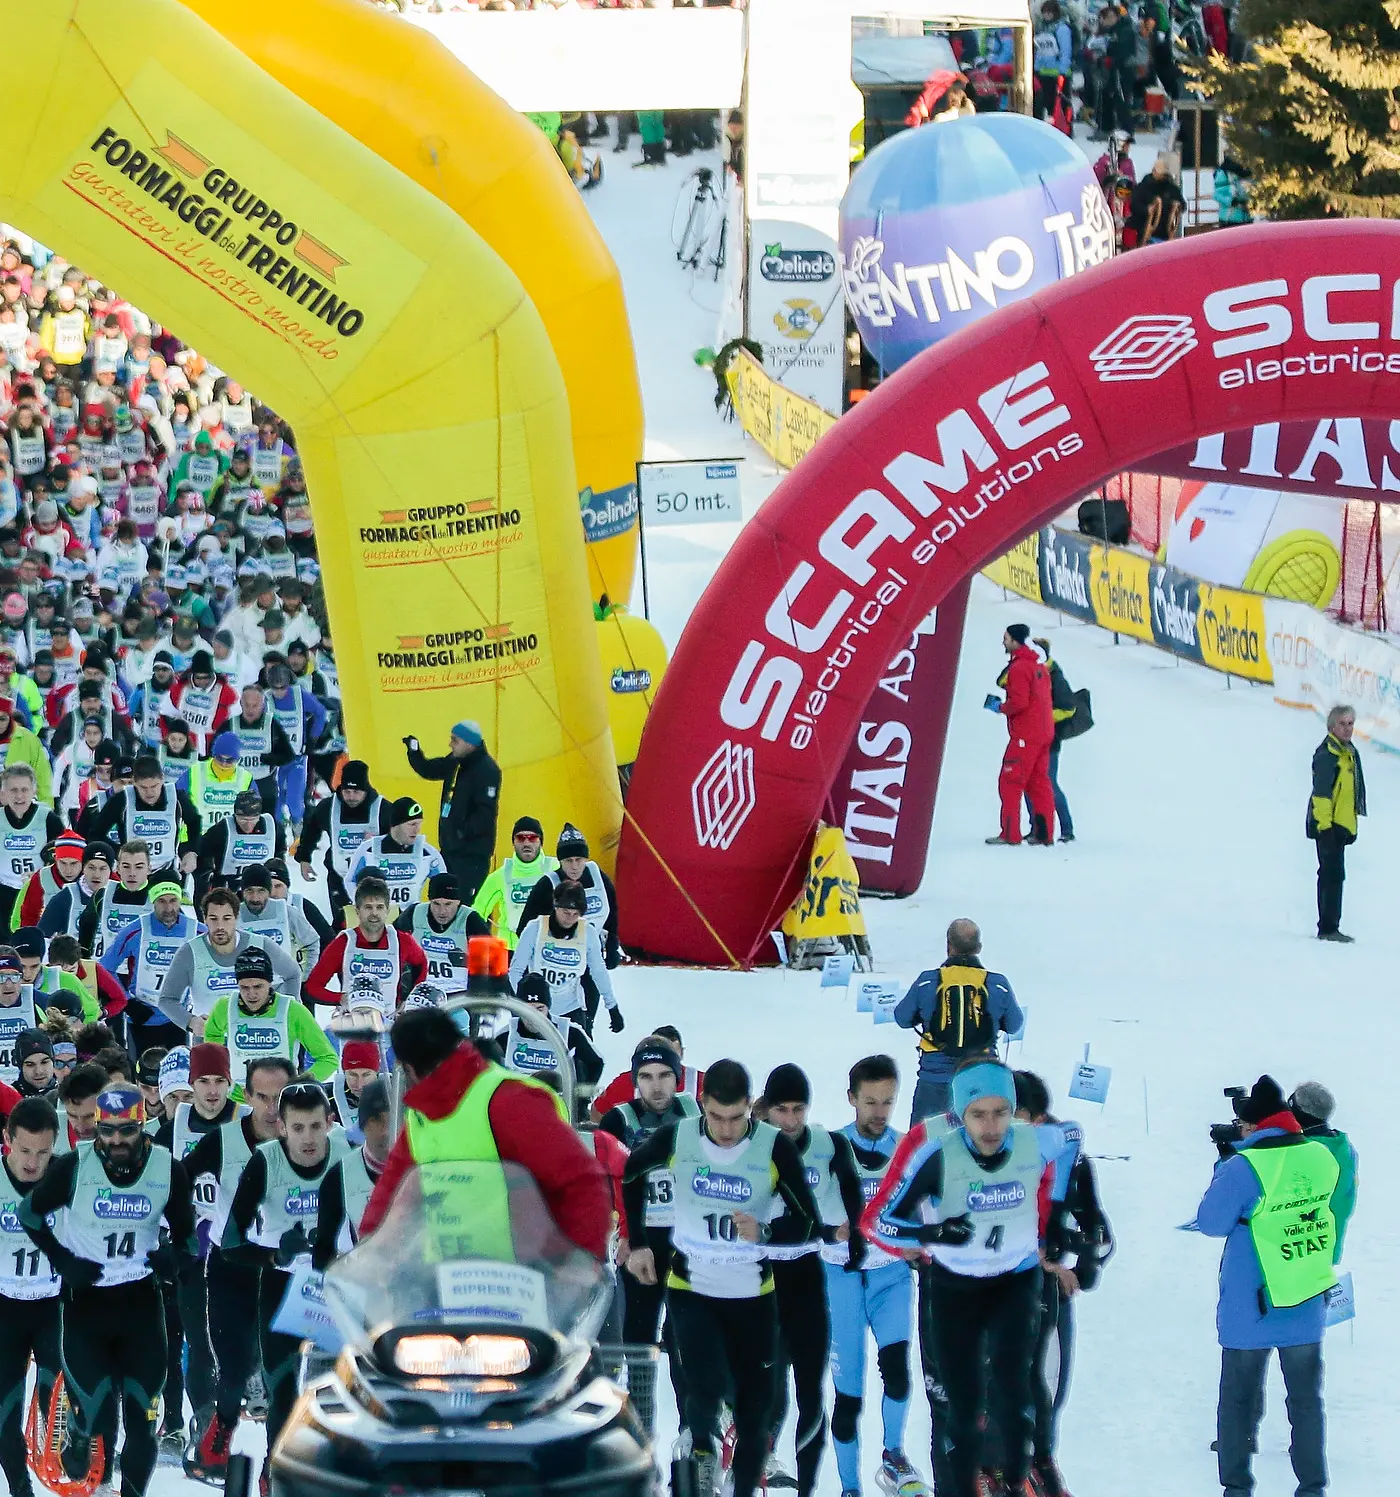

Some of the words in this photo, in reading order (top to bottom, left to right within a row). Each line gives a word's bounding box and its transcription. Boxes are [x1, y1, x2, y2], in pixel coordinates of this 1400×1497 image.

[202, 167, 299, 247] GRUPPO
[90, 127, 232, 246] FORMAGGI
[236, 234, 366, 339] TRENTINO
[70, 160, 176, 244] Gustatevi
[197, 250, 268, 310] nostro
[264, 297, 340, 361] mondo
[763, 254, 836, 276] Melinda
[1204, 273, 1400, 360] SC
[407, 503, 466, 523] GRUPPO
[657, 492, 688, 513] 50
[695, 491, 731, 511] mt.
[360, 524, 438, 544] FORMAGGI
[447, 509, 521, 537] TRENTINO
[720, 361, 1071, 742] SCAME
[1046, 548, 1089, 608] Melinda
[790, 568, 909, 750] electrical
[912, 432, 1084, 566] solutions
[1100, 568, 1143, 625] Melinda
[425, 628, 484, 649] GRUPPO
[1203, 605, 1260, 663] Melinda
[378, 650, 455, 669] FORMAGGI
[844, 721, 912, 867] ITAS
[134, 821, 171, 834] Melinda
[5, 836, 36, 848] Melinda
[232, 846, 269, 859] Melinda
[11, 857, 34, 874] 65
[422, 938, 456, 951] Melinda
[543, 949, 581, 963] Melinda
[350, 961, 393, 976] Melinda
[236, 1027, 280, 1043] Melinda
[513, 1049, 558, 1068] Melinda
[693, 1174, 752, 1199] Melinda
[968, 1185, 1026, 1208] Melinda
[94, 1196, 152, 1214] Melinda
[985, 1225, 1005, 1252] 4
[1284, 1224, 1307, 1237] Valle
[1308, 1221, 1315, 1232] di
[103, 1231, 137, 1259] 14
[11, 1247, 41, 1277] 11
